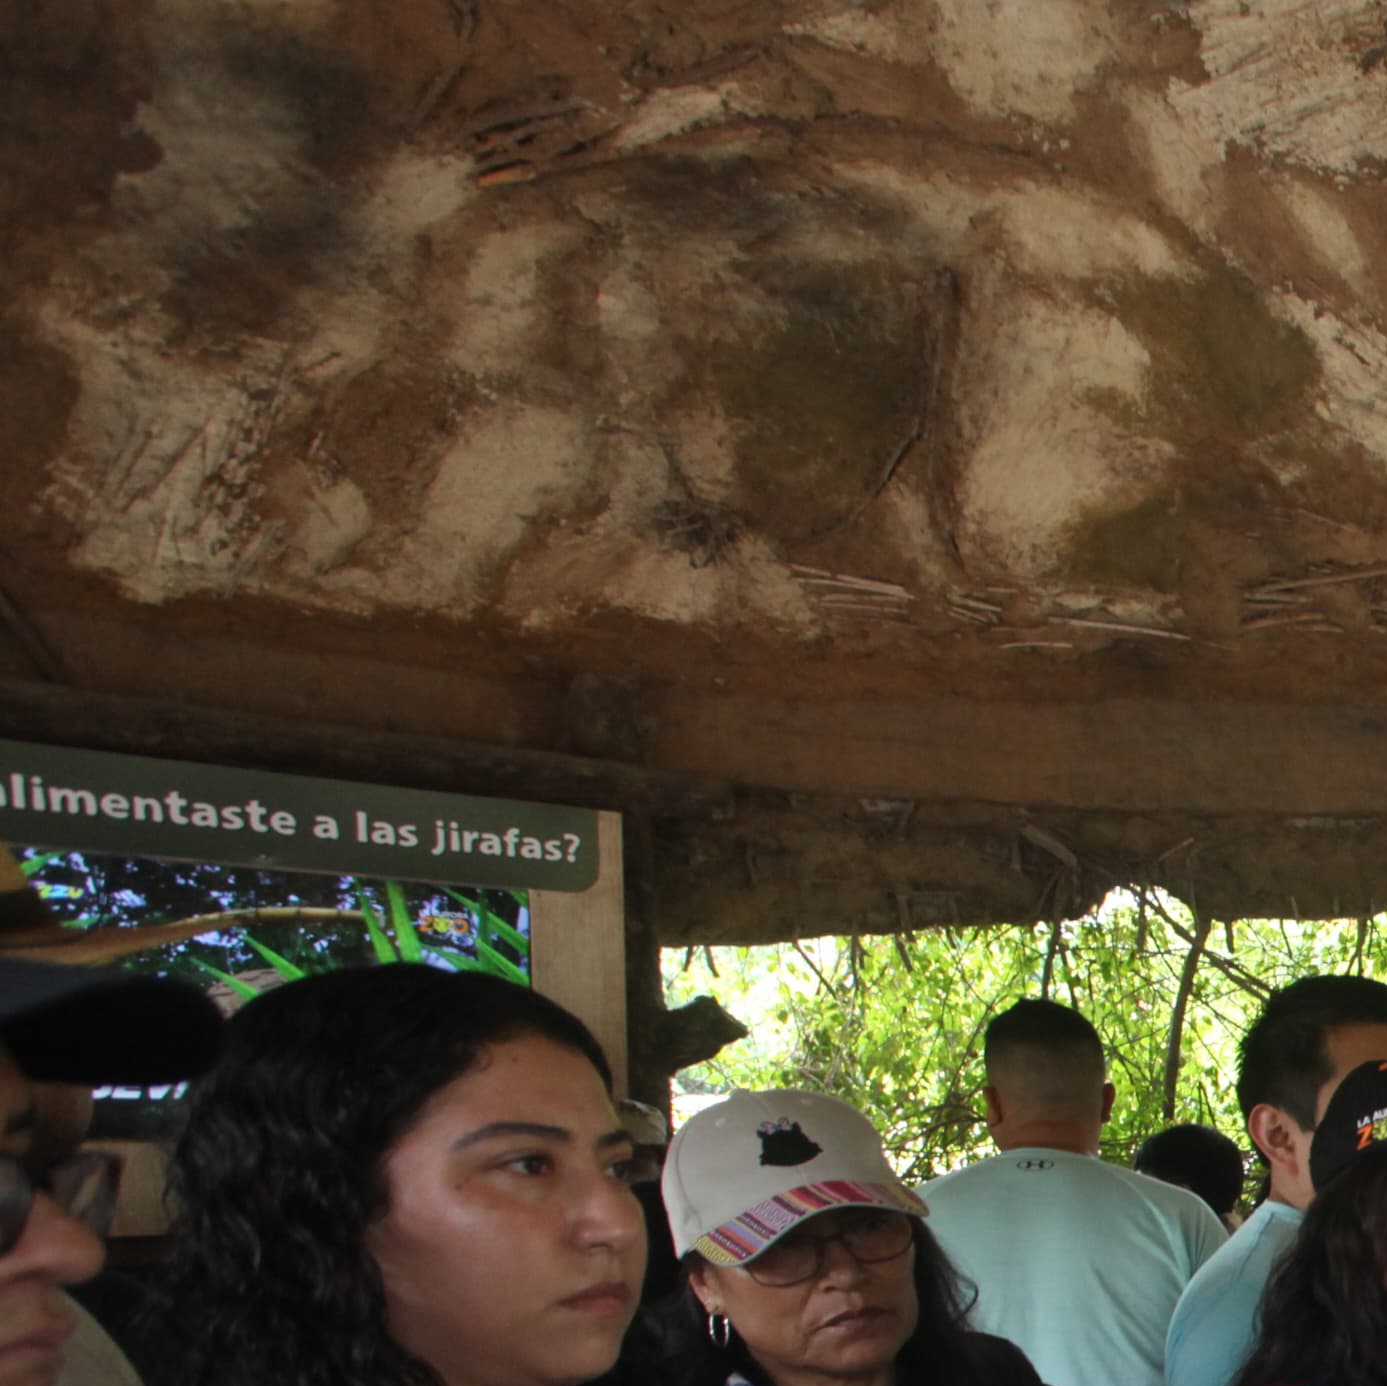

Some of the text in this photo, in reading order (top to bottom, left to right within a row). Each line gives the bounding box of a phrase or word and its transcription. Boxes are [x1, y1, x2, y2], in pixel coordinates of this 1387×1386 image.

[0, 772, 581, 863] limentaste a las jirafas?
[1357, 1115, 1371, 1129] LA
